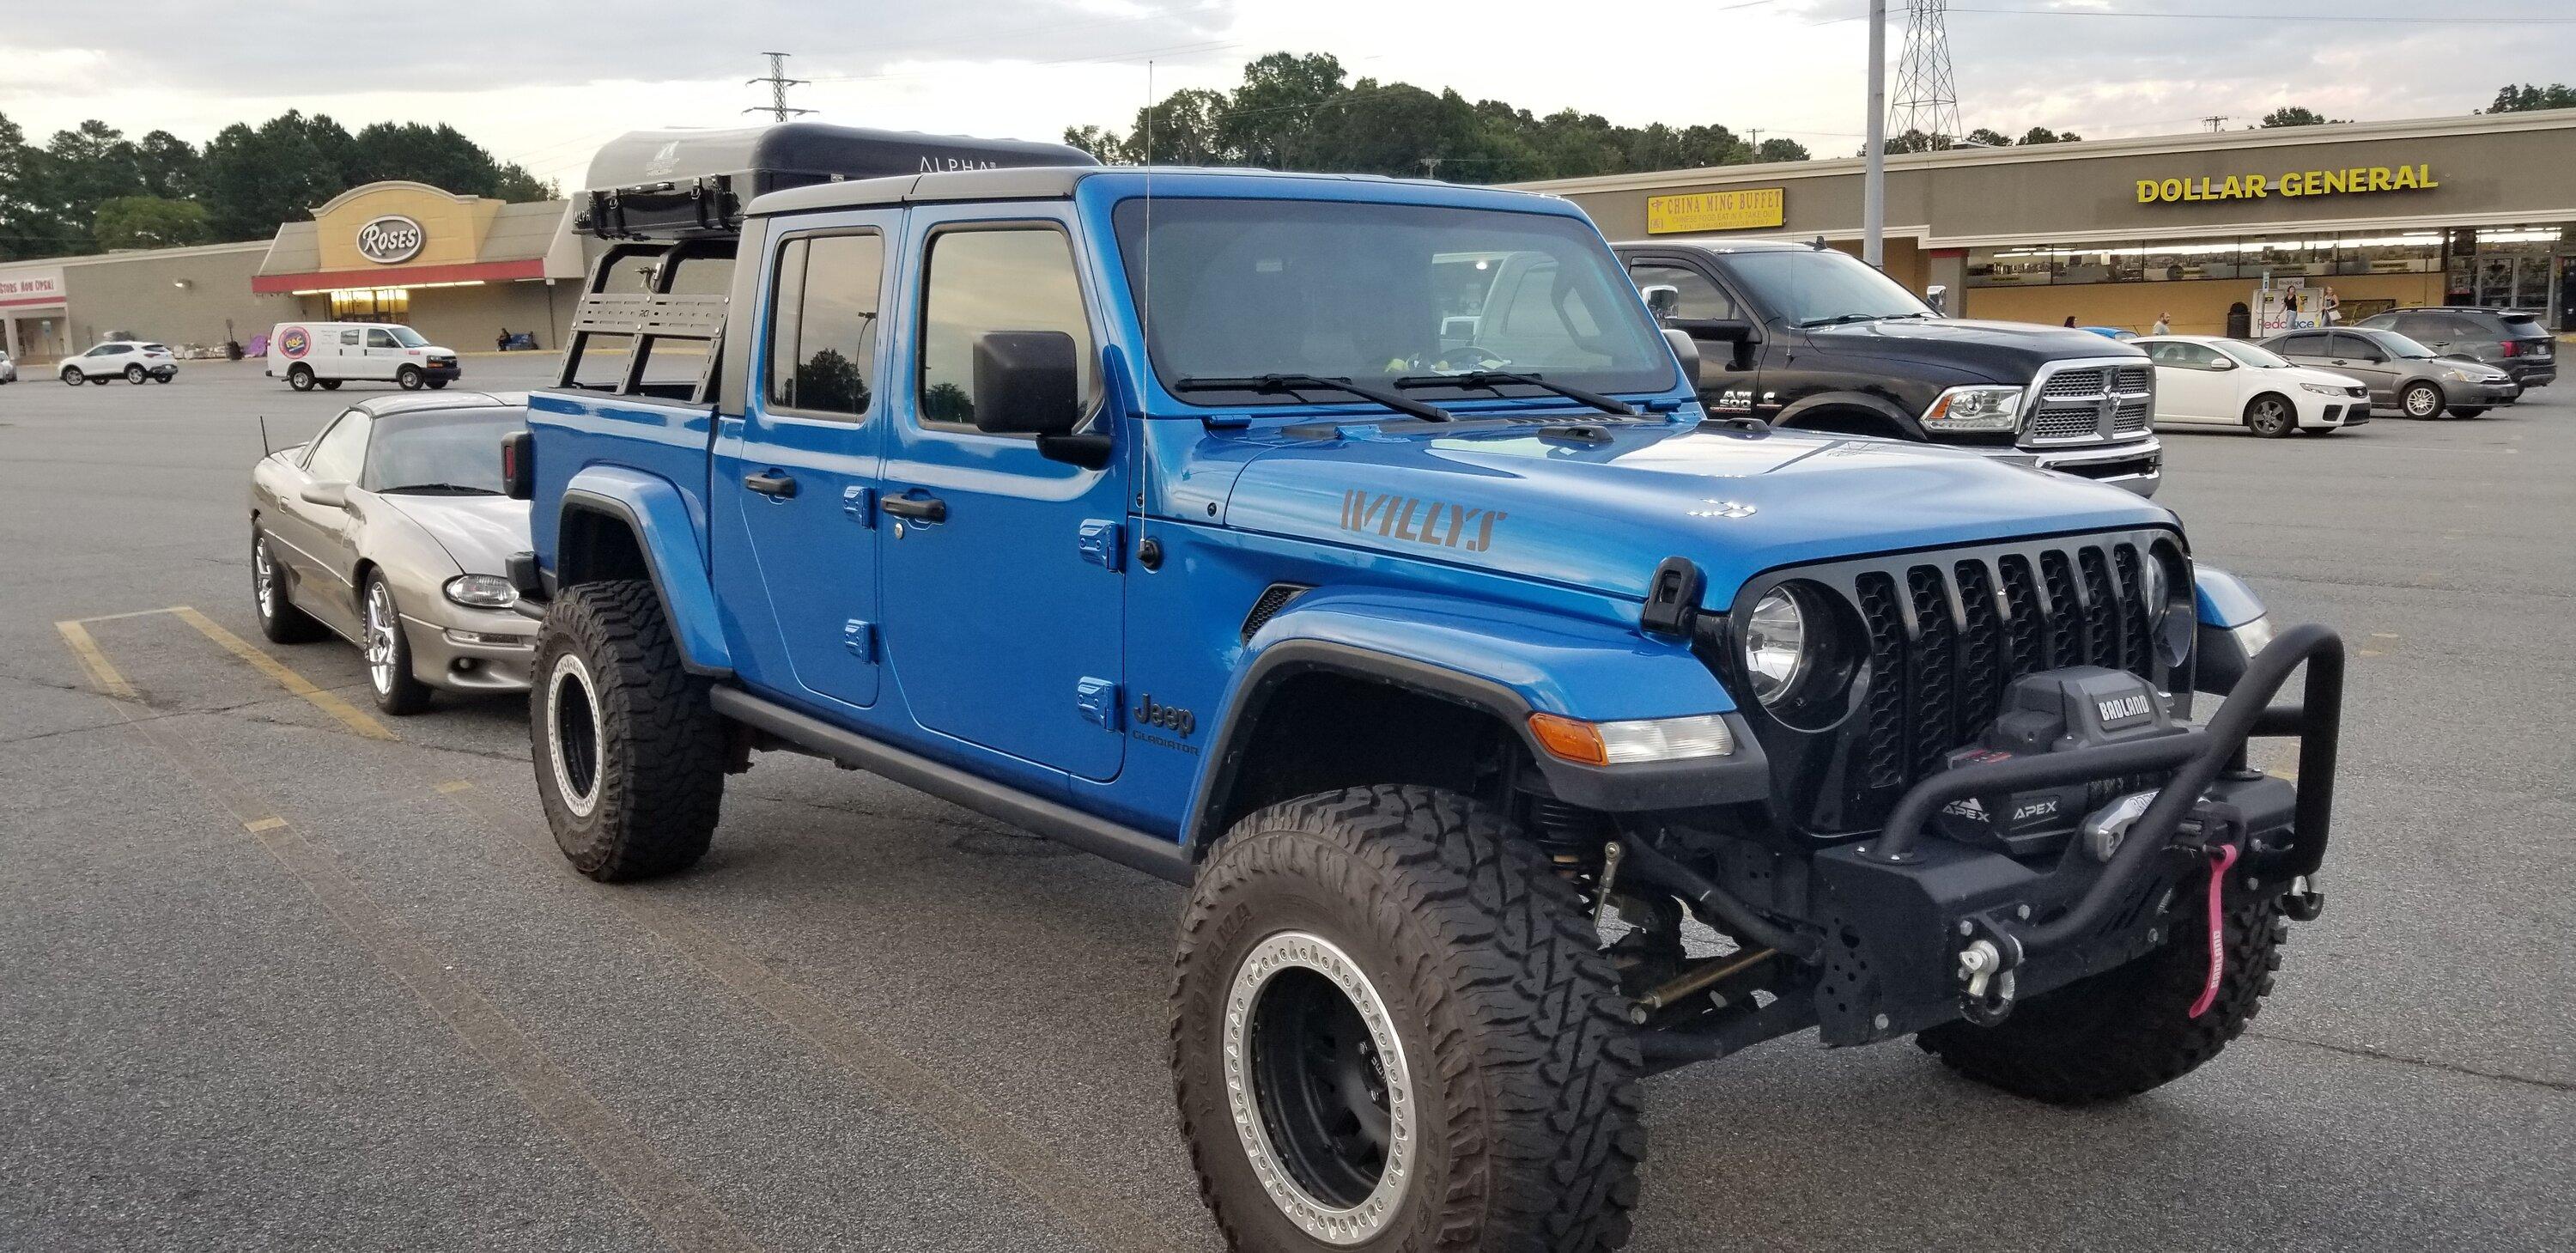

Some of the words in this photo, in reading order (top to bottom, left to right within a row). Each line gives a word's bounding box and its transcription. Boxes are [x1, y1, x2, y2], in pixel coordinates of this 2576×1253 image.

[2136, 174, 2268, 203] DOLLAR
[2279, 163, 2439, 198] GENERAL
[1668, 196, 1700, 215] CHINA
[1706, 193, 1733, 212] MING
[1740, 191, 1781, 210] BUFFET
[21, 281, 33, 292] NOW
[1340, 489, 1509, 553] WILLYS
[1133, 693, 1195, 739] Jeep
[2098, 694, 2151, 721] BADLAND
[1133, 729, 1200, 756] GLADIATOR
[1942, 803, 1990, 823] APEX
[2013, 800, 2058, 820] APEX
[2210, 929, 2224, 989] BADLAND
